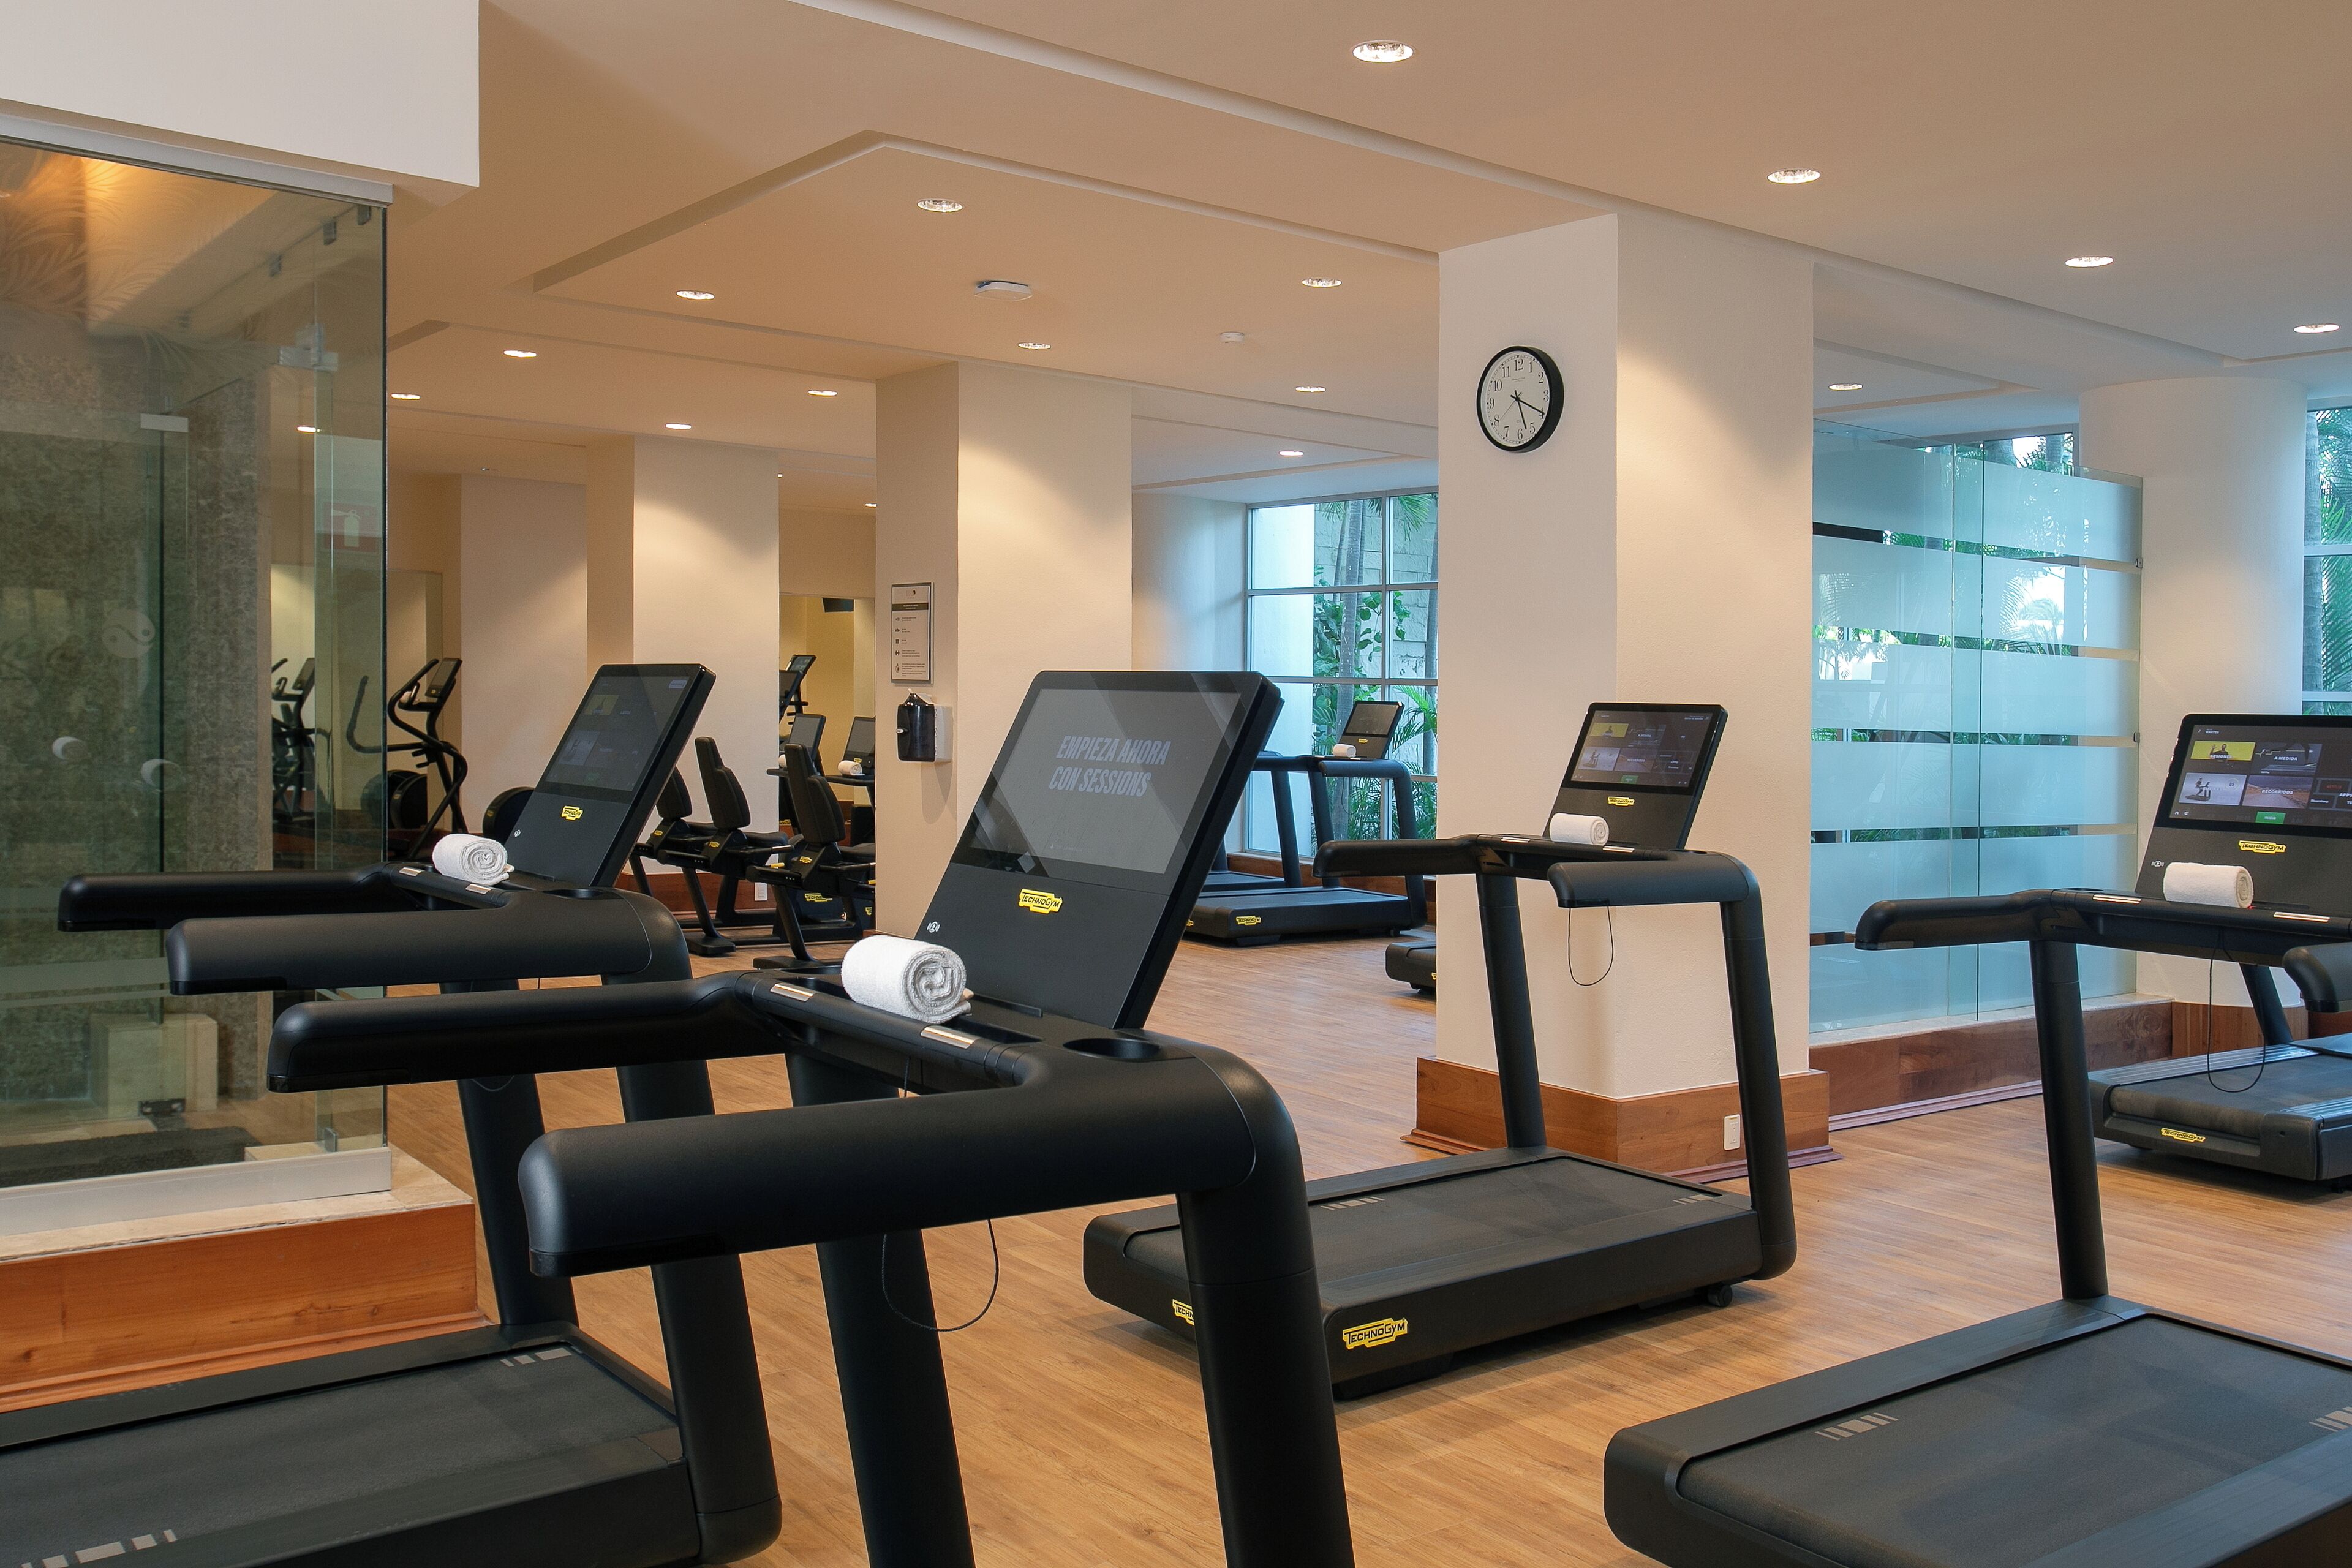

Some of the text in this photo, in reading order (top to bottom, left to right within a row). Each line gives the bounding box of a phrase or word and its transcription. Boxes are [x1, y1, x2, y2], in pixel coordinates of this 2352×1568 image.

[1514, 358, 1524, 371] 12
[1528, 361, 1533, 373] 1
[1502, 366, 1510, 378] 11
[1538, 372, 1544, 383] 2
[1493, 380, 1502, 391] 10
[1544, 390, 1549, 401] 3
[1489, 398, 1495, 409] 9
[1494, 414, 1500, 426] 8
[1504, 426, 1510, 437] 7
[1517, 428, 1523, 440] 6
[1529, 422, 1536, 434] 5
[1056, 735, 1172, 766] EMPIEZA AHORA
[1049, 766, 1152, 797] CON SESSIONS
[1173, 1302, 1194, 1321] TECHN
[1344, 1321, 1406, 1344] TECHNOGYM
